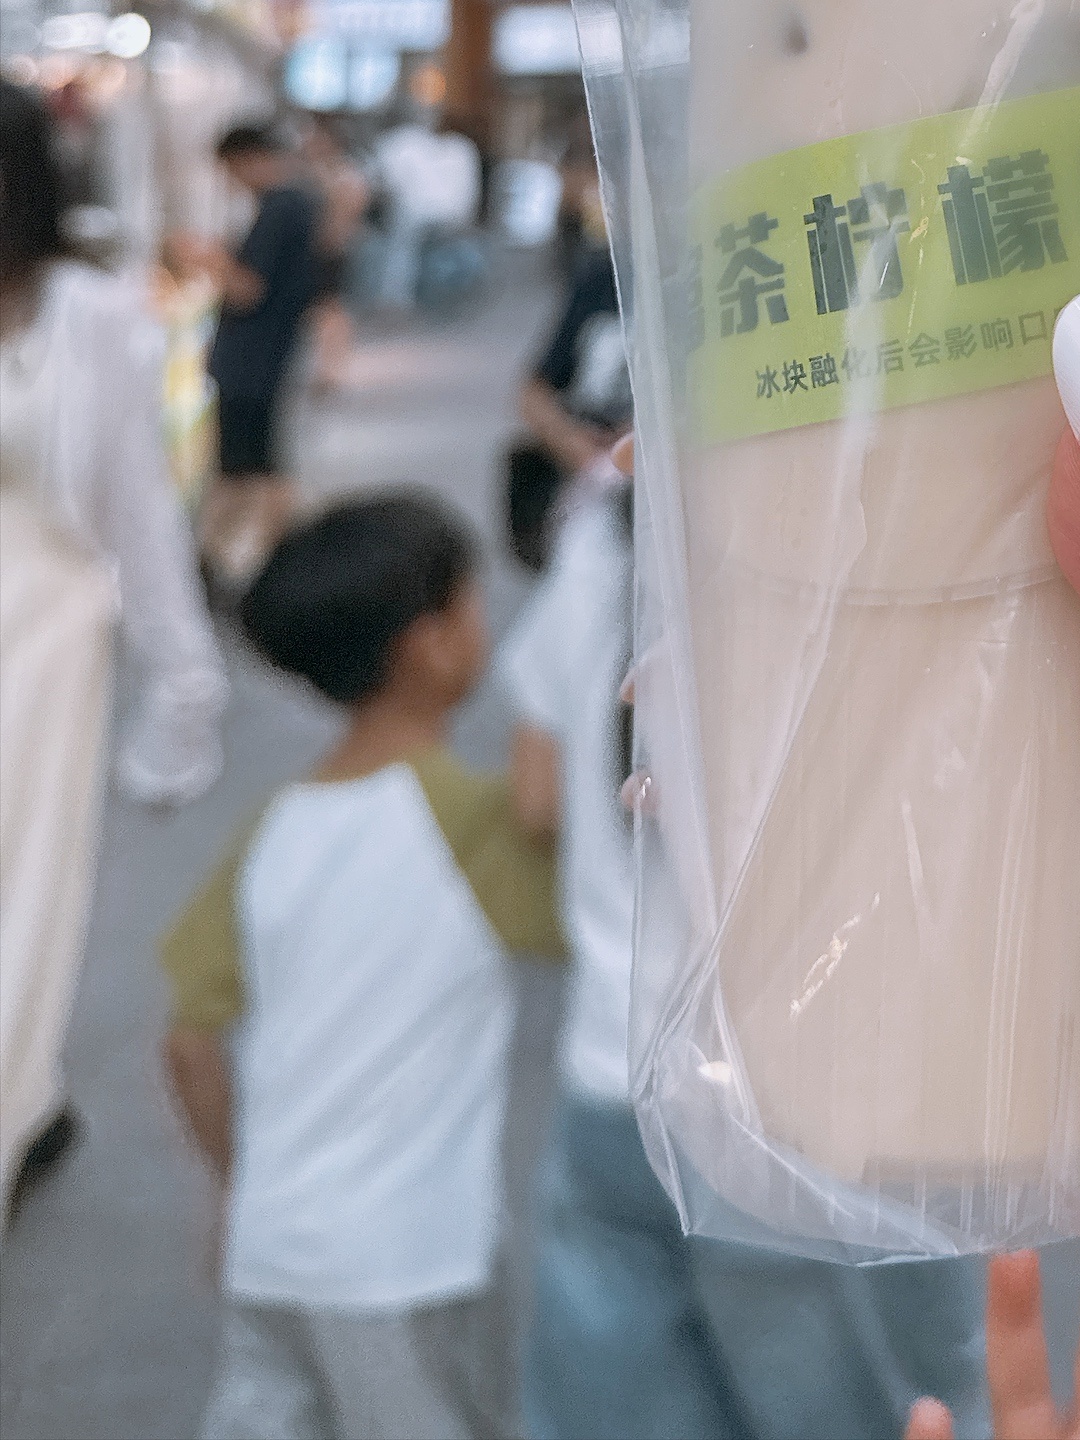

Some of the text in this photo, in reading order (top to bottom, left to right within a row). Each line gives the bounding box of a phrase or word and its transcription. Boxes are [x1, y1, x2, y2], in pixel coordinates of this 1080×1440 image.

[756, 308, 1062, 399] 冰块融化后会影响口
